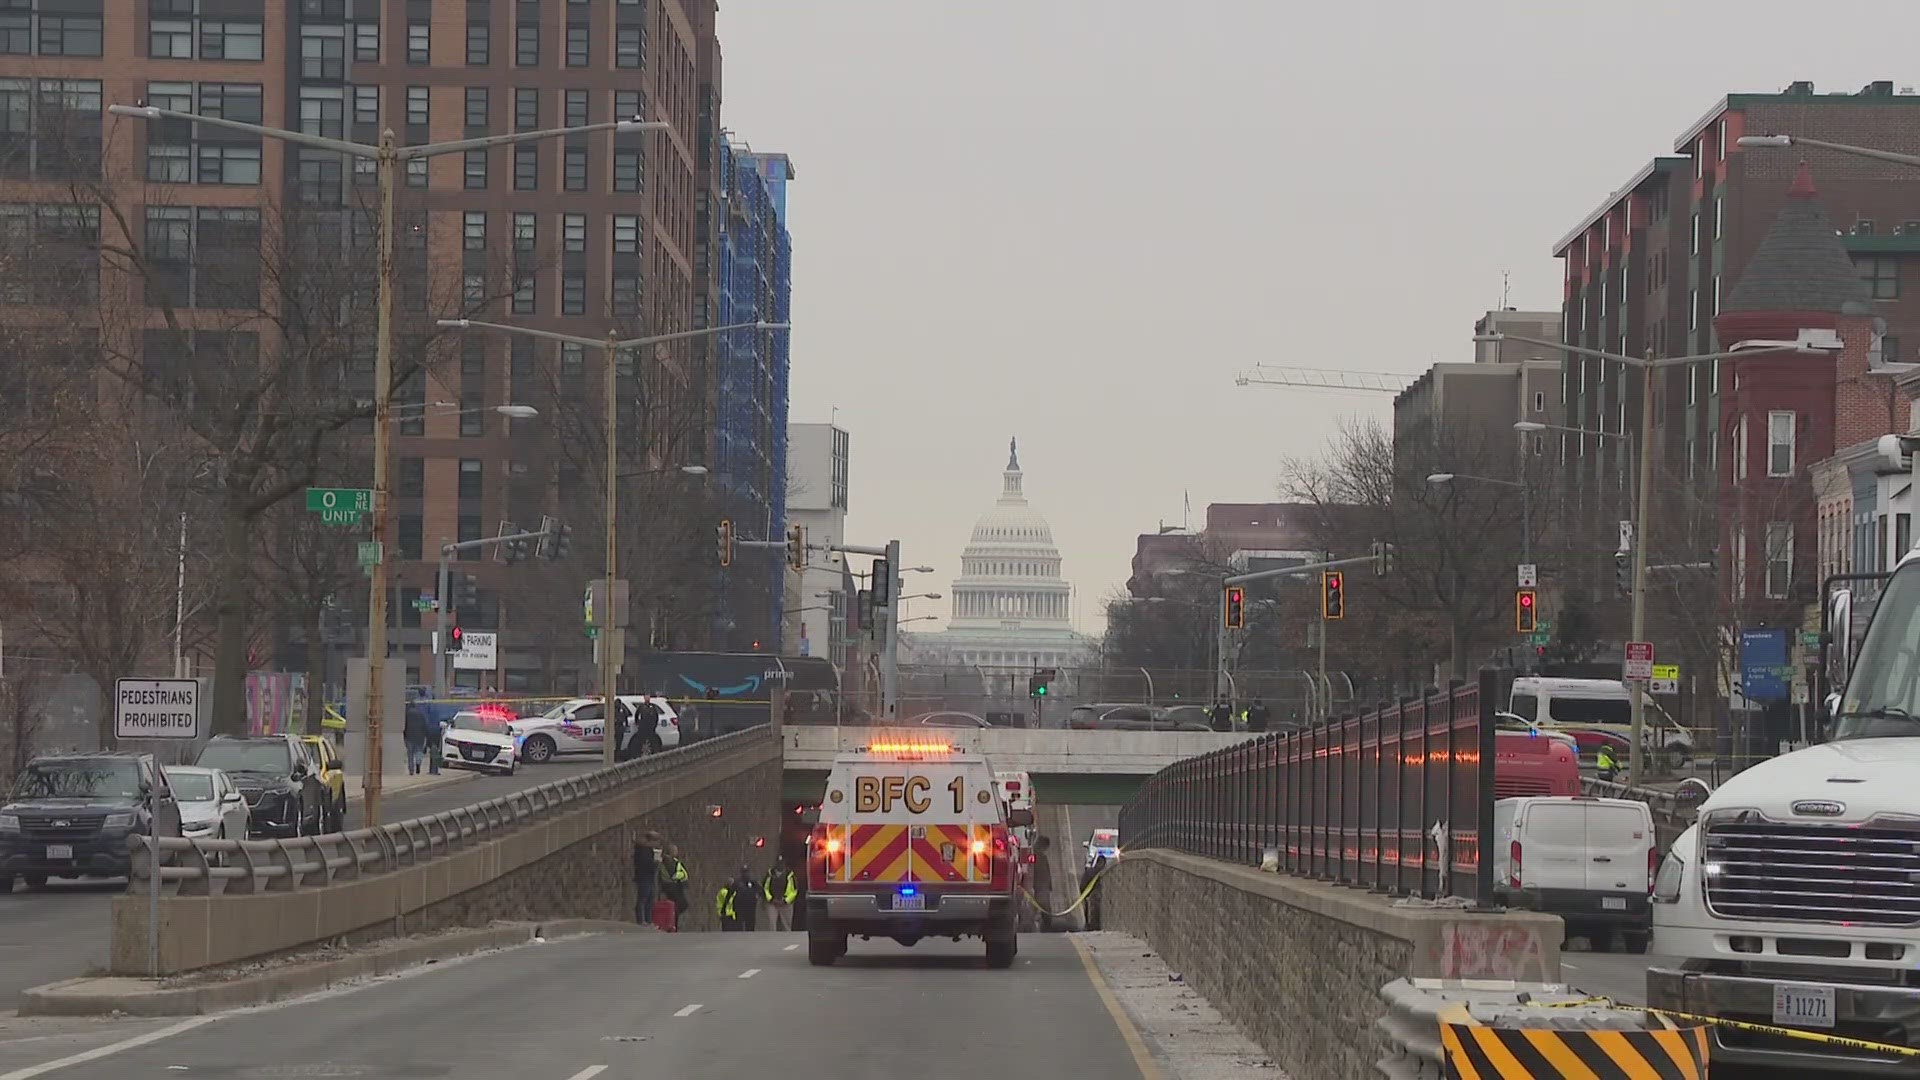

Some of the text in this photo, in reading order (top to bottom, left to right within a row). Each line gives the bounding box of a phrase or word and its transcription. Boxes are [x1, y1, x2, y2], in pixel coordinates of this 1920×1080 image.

[356, 492, 367, 501] St
[355, 501, 368, 510] NE
[322, 511, 356, 522] UNIT
[467, 635, 492, 646] PARKING
[121, 690, 193, 705] PEDESTRIANS
[125, 713, 192, 728] PROHIBITED
[855, 776, 964, 814] BFC 1
[1796, 997, 1827, 1018] 11271
